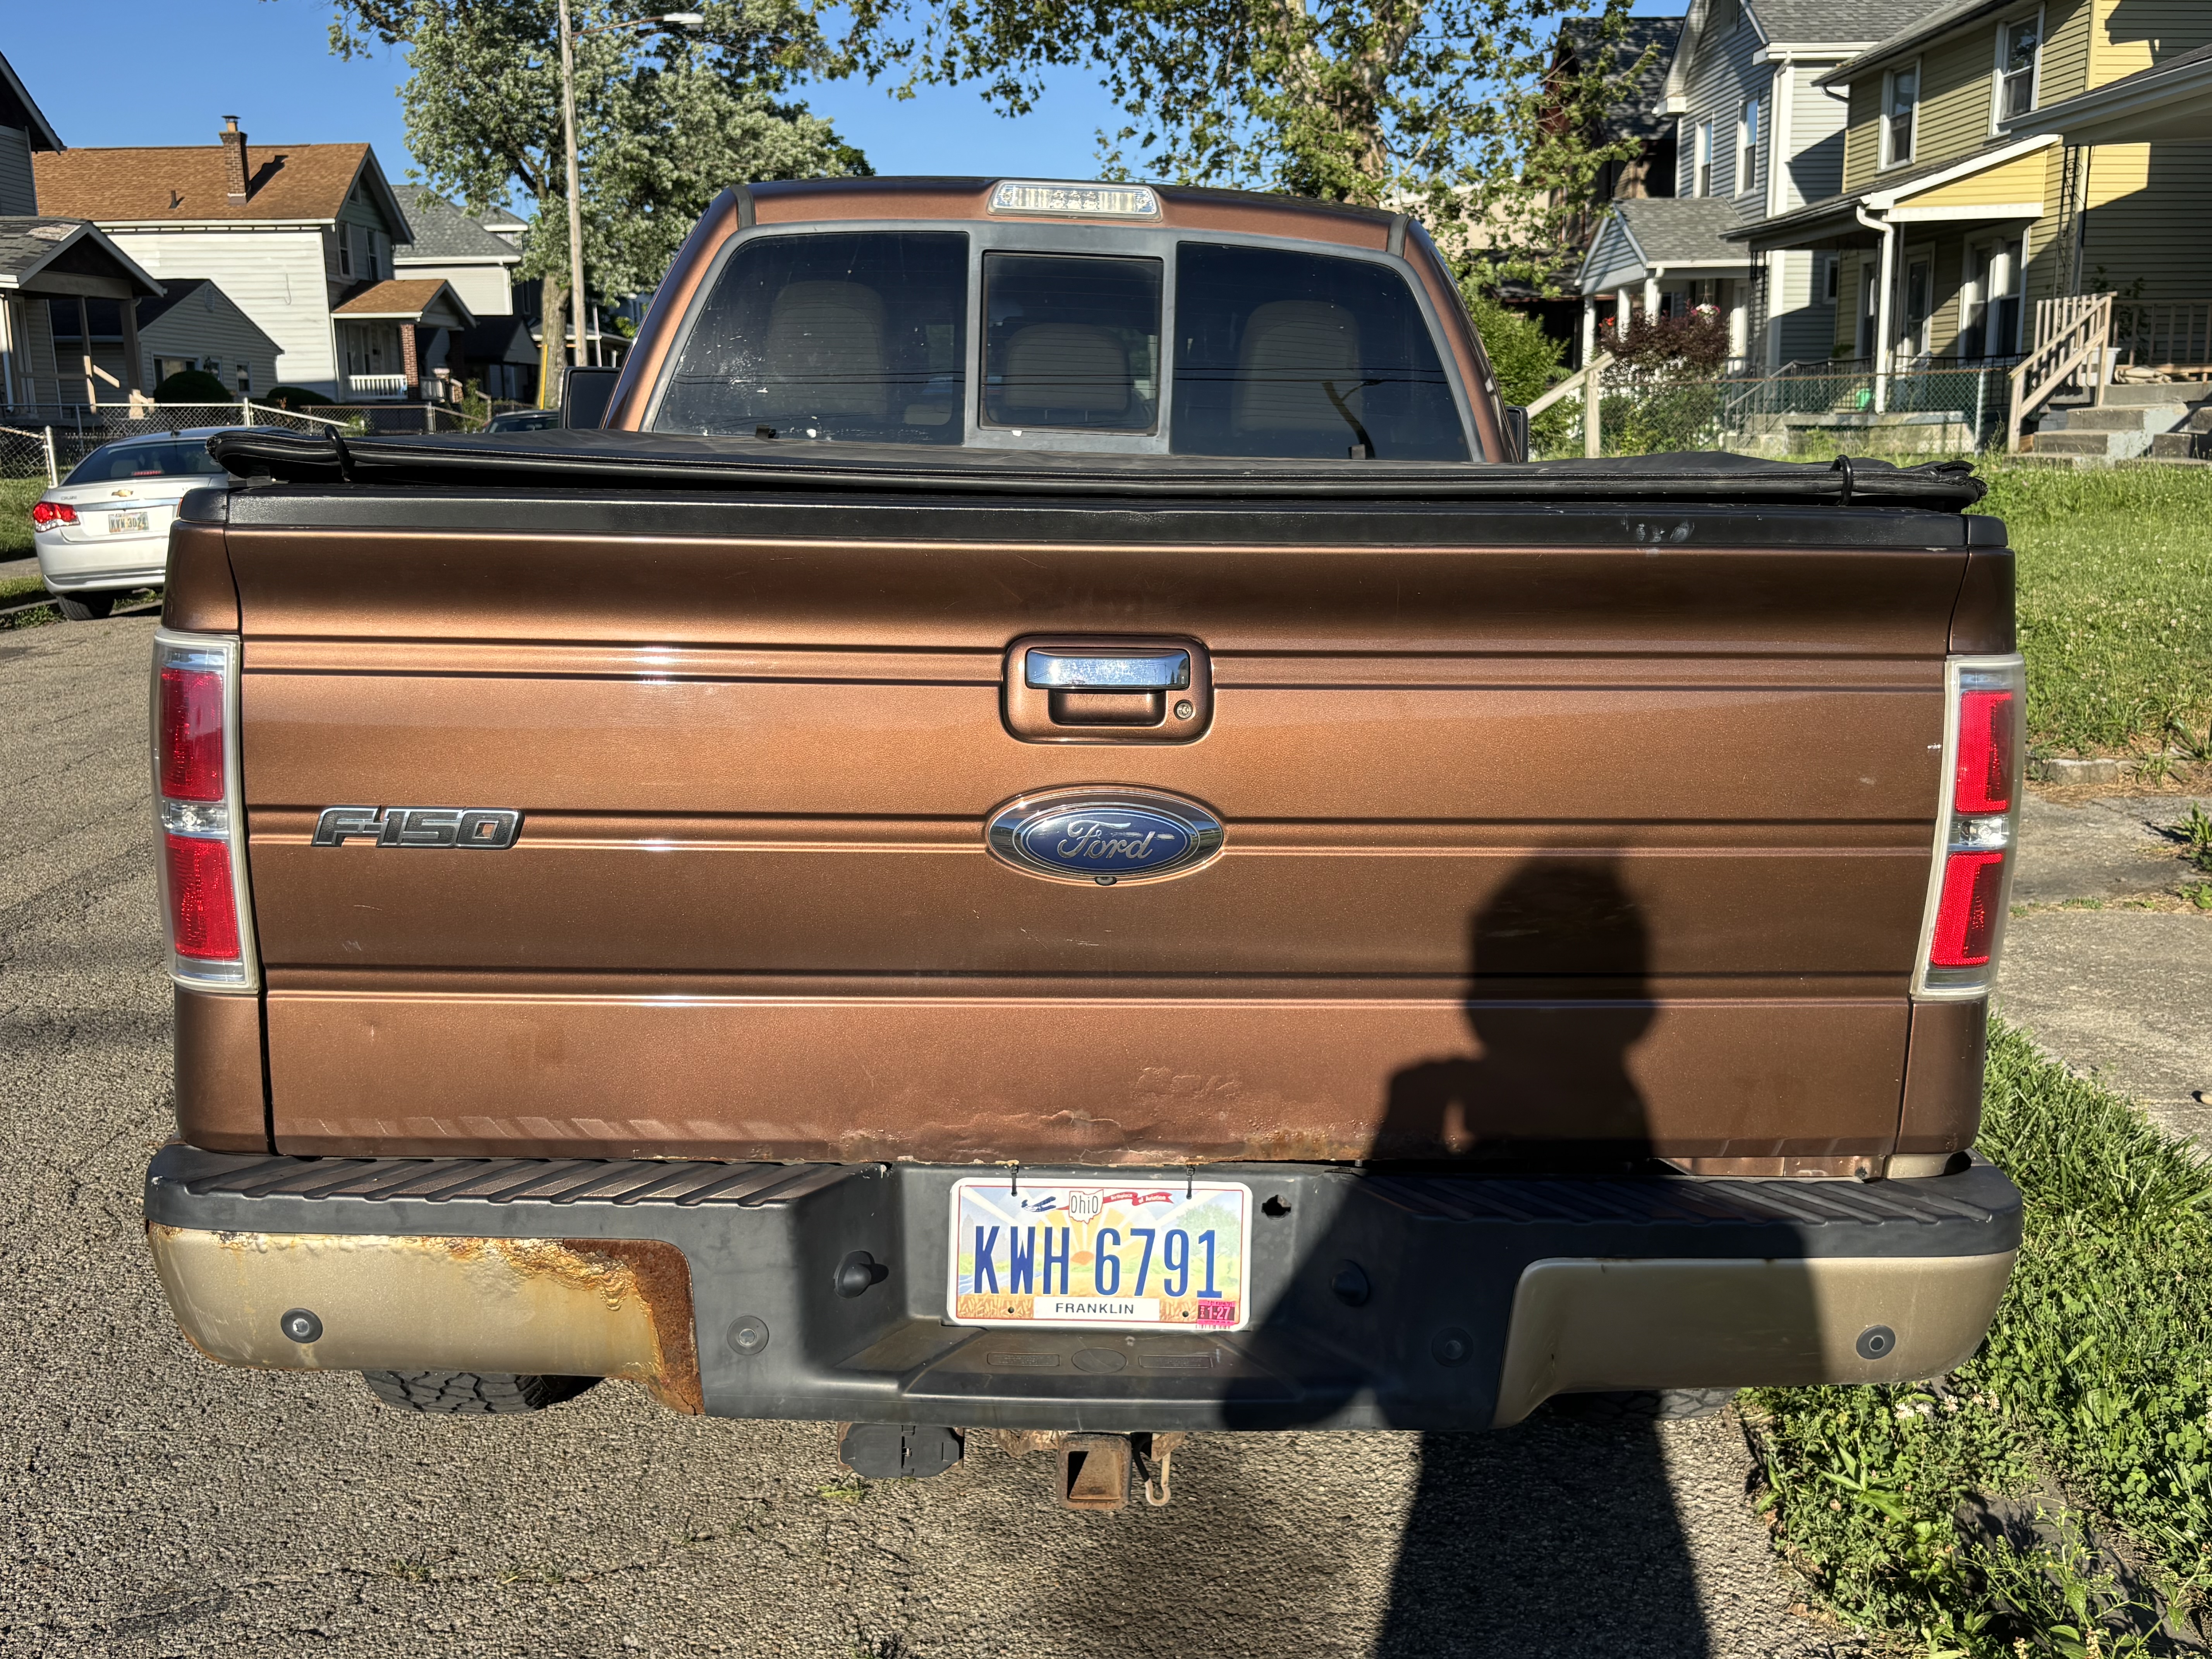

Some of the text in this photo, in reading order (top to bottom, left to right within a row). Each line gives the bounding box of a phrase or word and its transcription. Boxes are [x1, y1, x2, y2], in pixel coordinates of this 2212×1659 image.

[311, 805, 525, 850] F-150
[1057, 819, 1156, 859] Ford
[974, 1226, 1222, 1298] KWH 6791
[1056, 1303, 1134, 1314] FRANKLIN
[1207, 1305, 1230, 1320] 1-27
